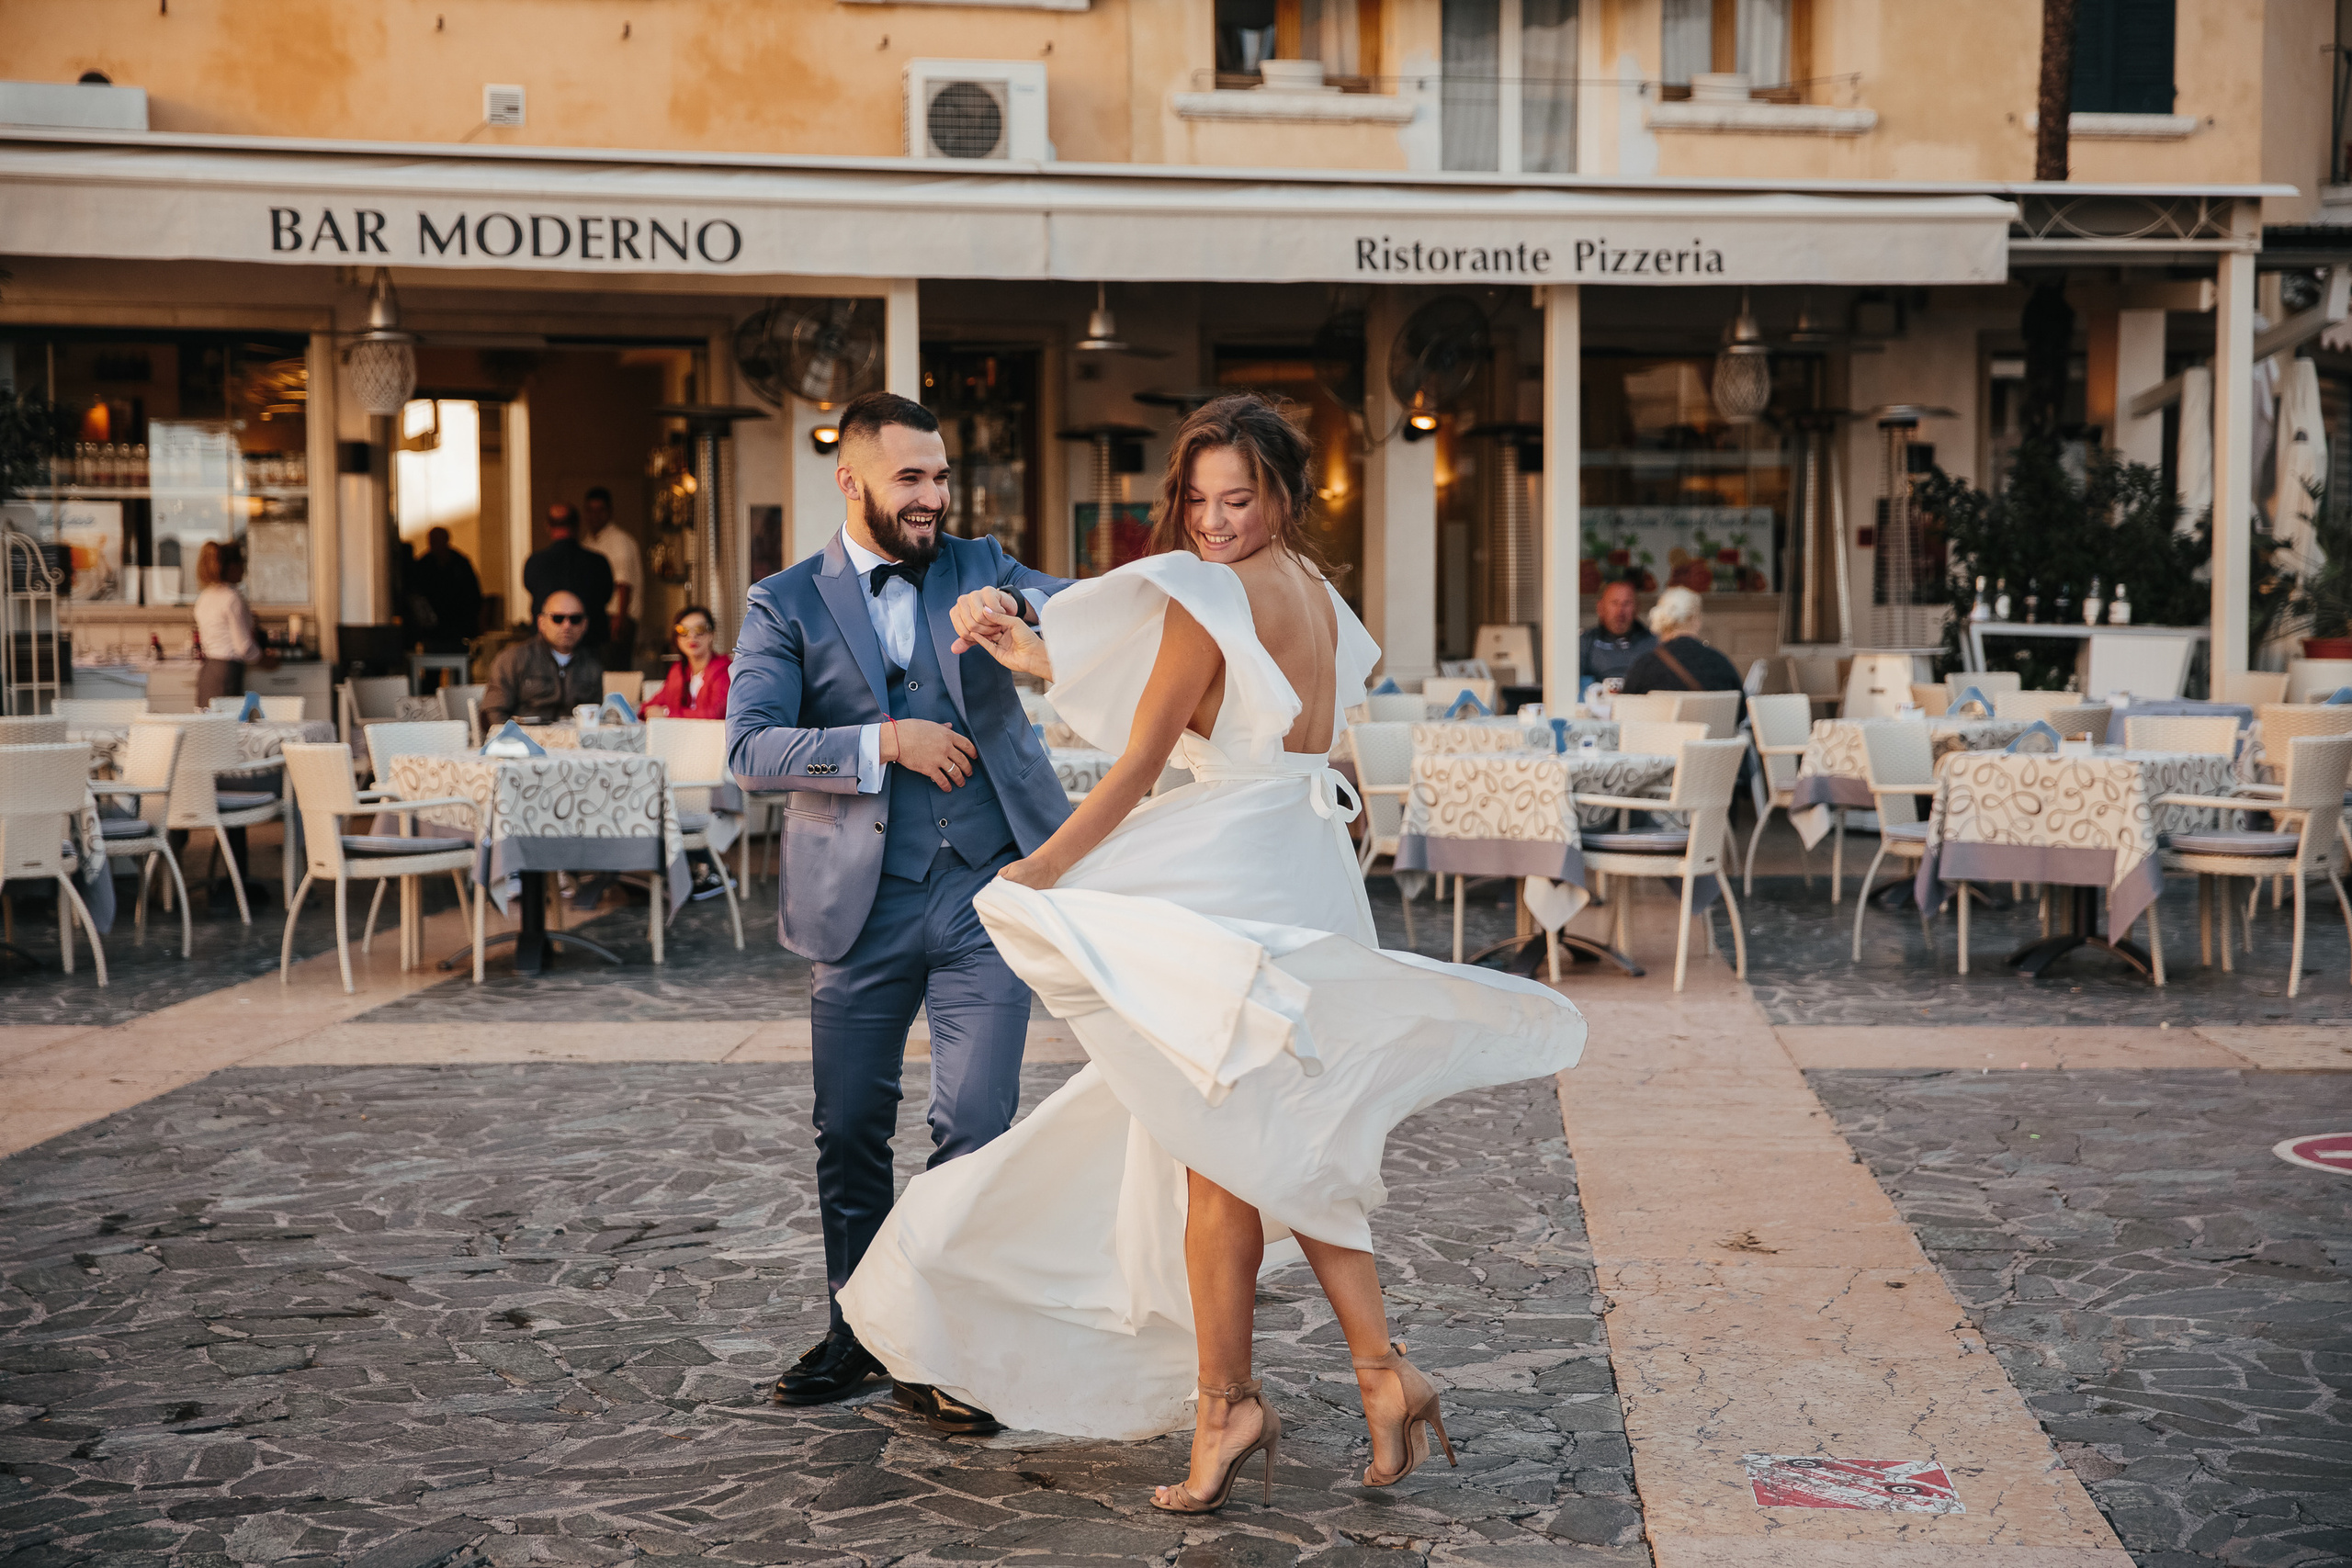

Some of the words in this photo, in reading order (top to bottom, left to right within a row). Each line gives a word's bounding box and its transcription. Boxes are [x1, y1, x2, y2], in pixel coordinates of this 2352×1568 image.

[268, 207, 390, 254] BAR
[418, 211, 742, 263] MODERNO
[1355, 235, 1551, 274] Ristorante
[1575, 237, 1724, 275] Pizzeria
